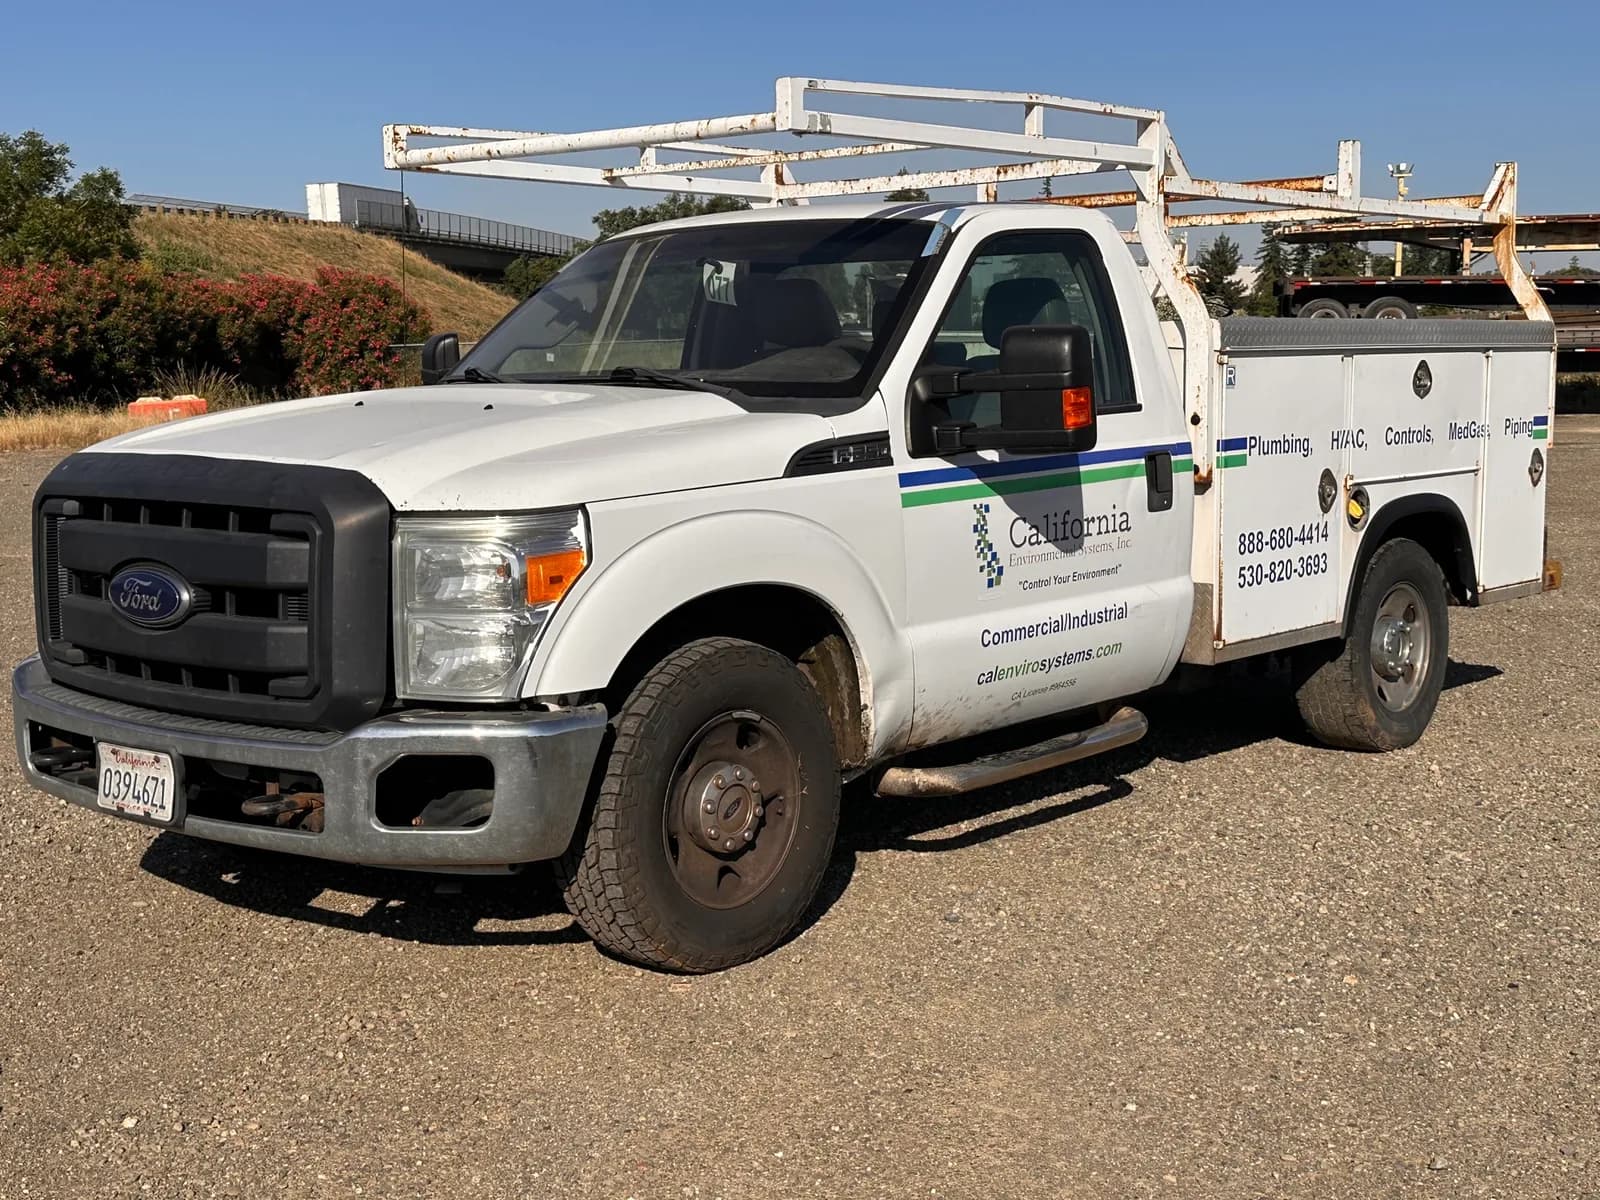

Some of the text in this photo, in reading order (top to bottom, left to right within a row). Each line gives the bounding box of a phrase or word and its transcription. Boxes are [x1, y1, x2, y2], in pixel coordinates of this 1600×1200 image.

[1248, 433, 1313, 457] Plumbing,
[1331, 428, 1368, 451] HVAC,
[1385, 424, 1434, 446] Controls,
[1504, 417, 1534, 438] Piping
[1009, 504, 1132, 548] California
[1238, 520, 1328, 556] 888-680-4414
[1009, 543, 1076, 567] Environmental
[1238, 552, 1328, 589] 530-820-3693
[120, 577, 162, 612] Ford
[1018, 563, 1122, 591] "Control Your Environment"
[981, 601, 1128, 648] Commercial/Industrial
[977, 642, 1122, 685] calenvirosystems.com
[115, 750, 161, 770] California
